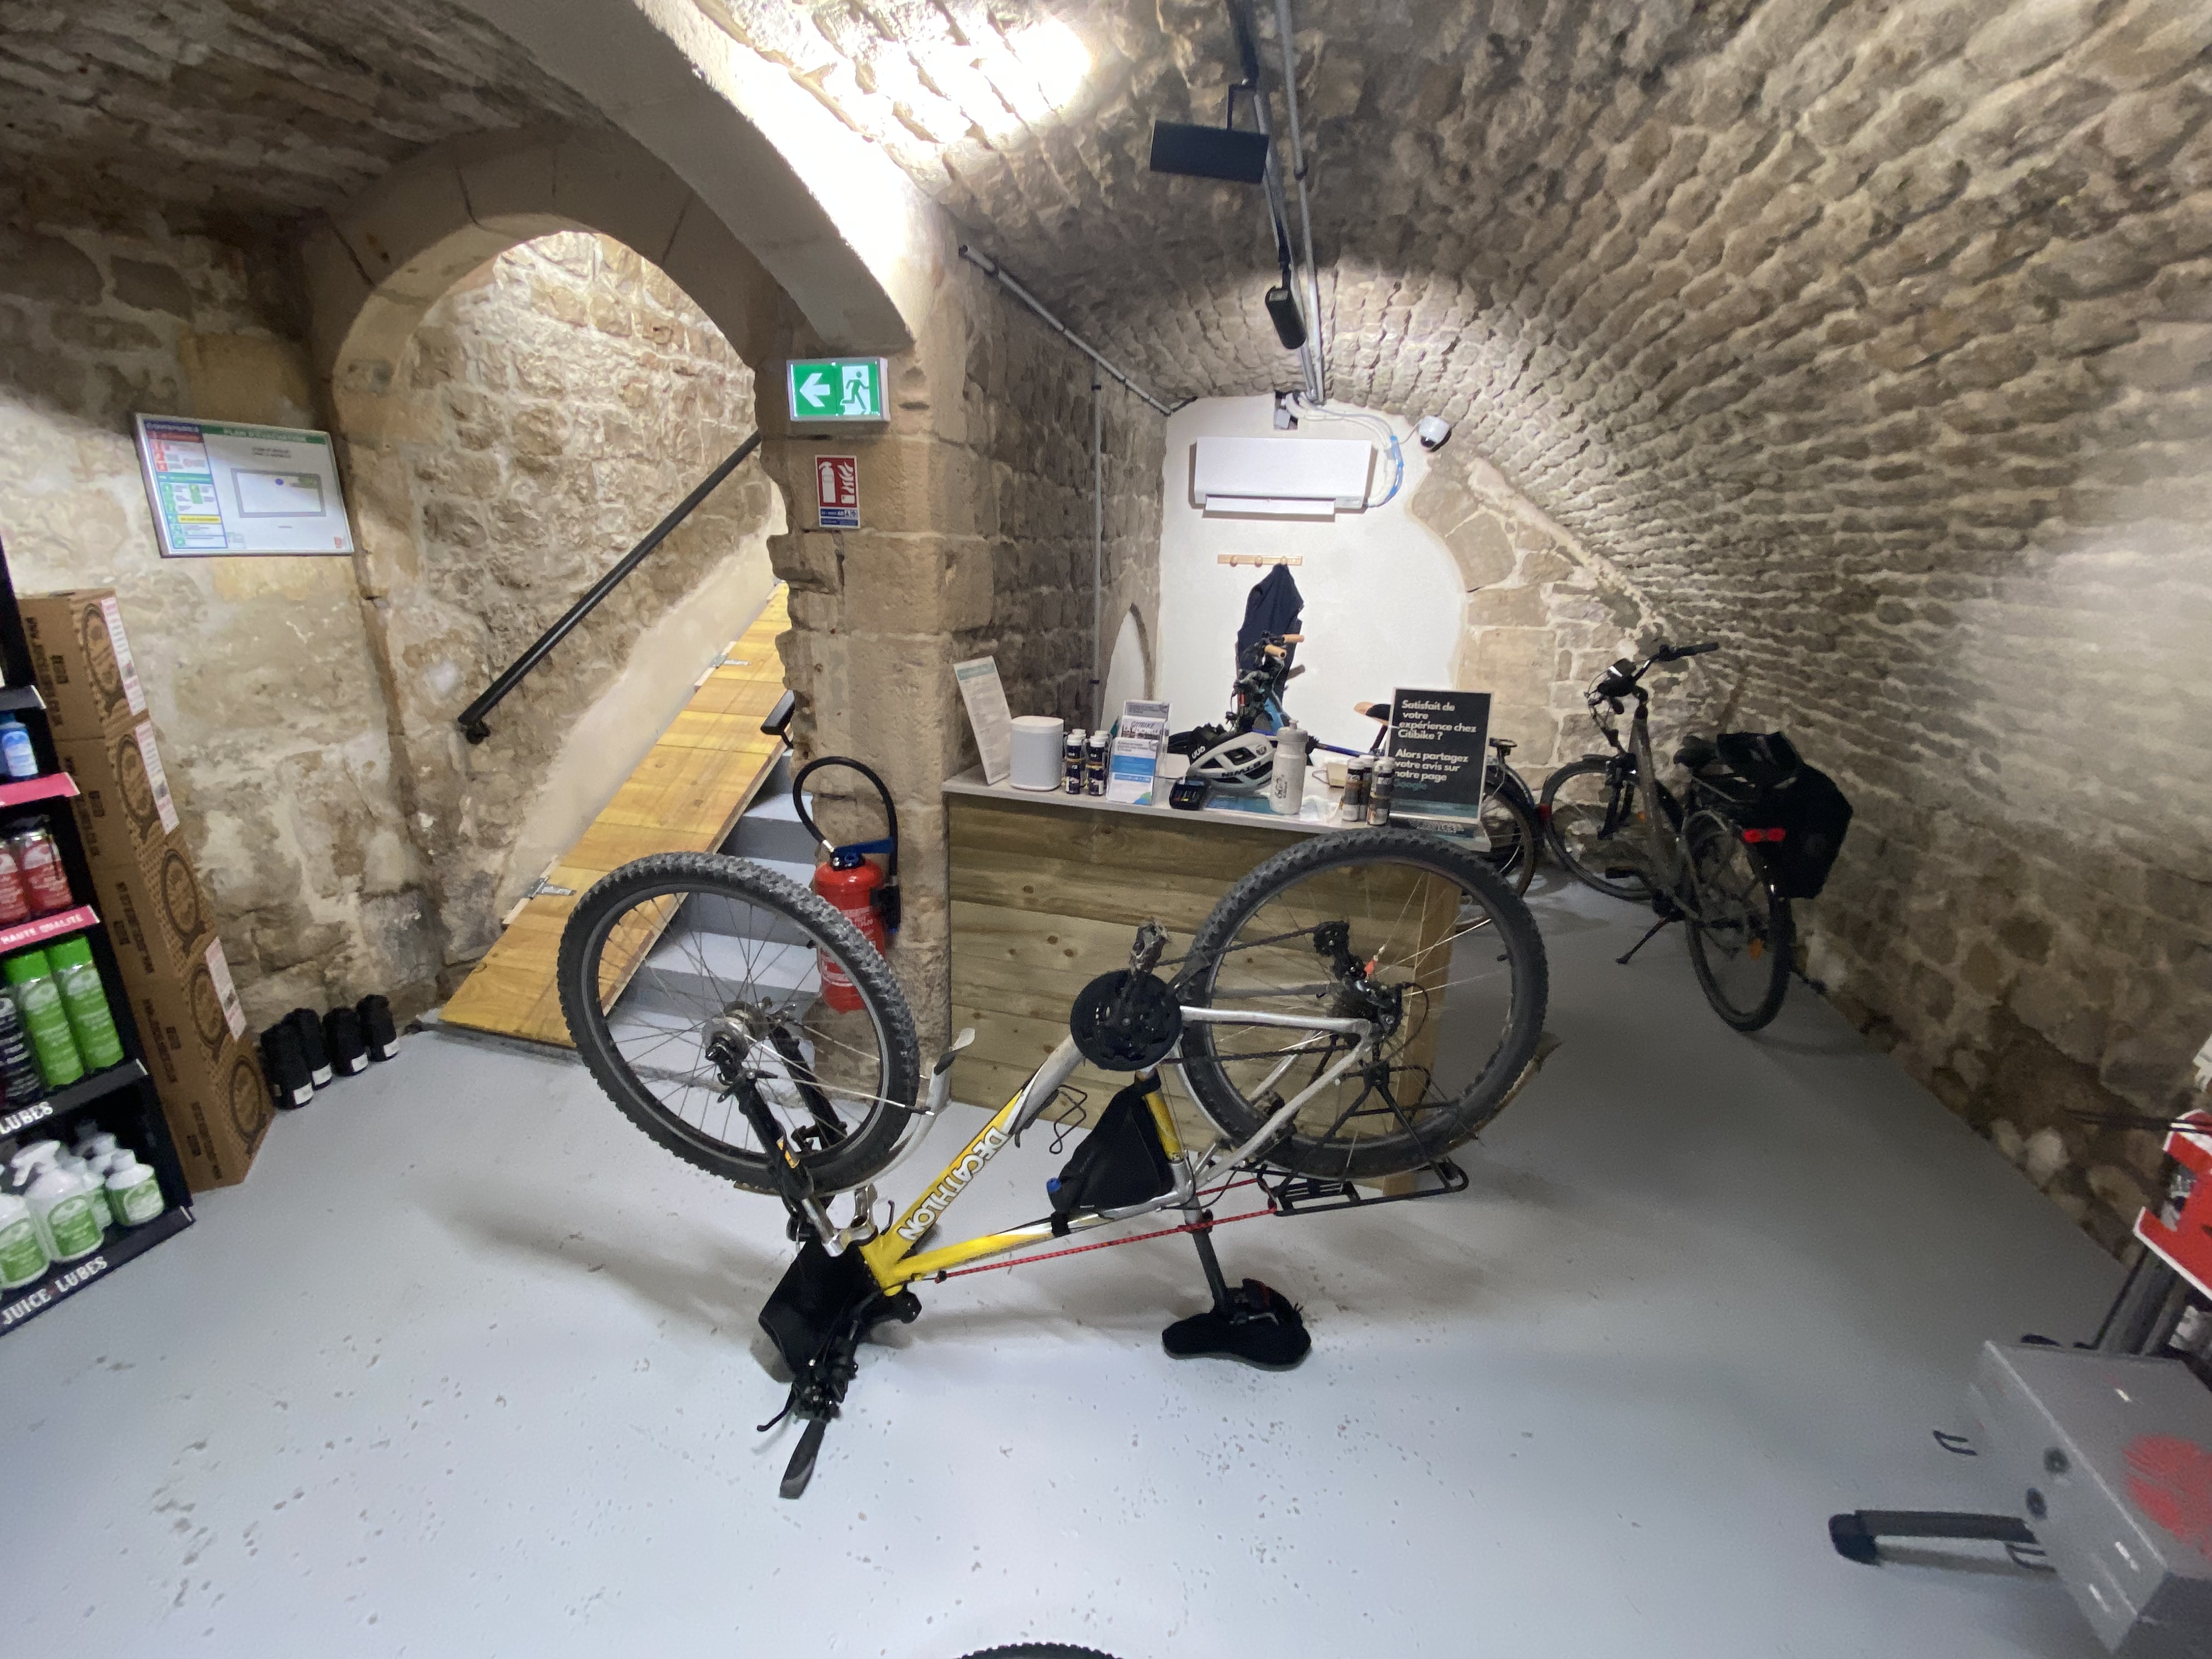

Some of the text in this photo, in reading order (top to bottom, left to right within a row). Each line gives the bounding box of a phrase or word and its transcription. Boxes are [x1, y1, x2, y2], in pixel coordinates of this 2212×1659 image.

[1402, 699, 1455, 711] Satisfait de
[1399, 720, 1476, 732] expérience chez
[1398, 729, 1443, 740] Citibike ?
[1395, 748, 1469, 764] Alors partagez
[1395, 760, 1421, 769] votre
[1422, 761, 1442, 771] avis
[1395, 770, 1447, 783] notre page
[0, 1101, 54, 1135] LUBES
[897, 1126, 1011, 1241] DECATHLON
[2, 1256, 108, 1325] JUICE LUBES
